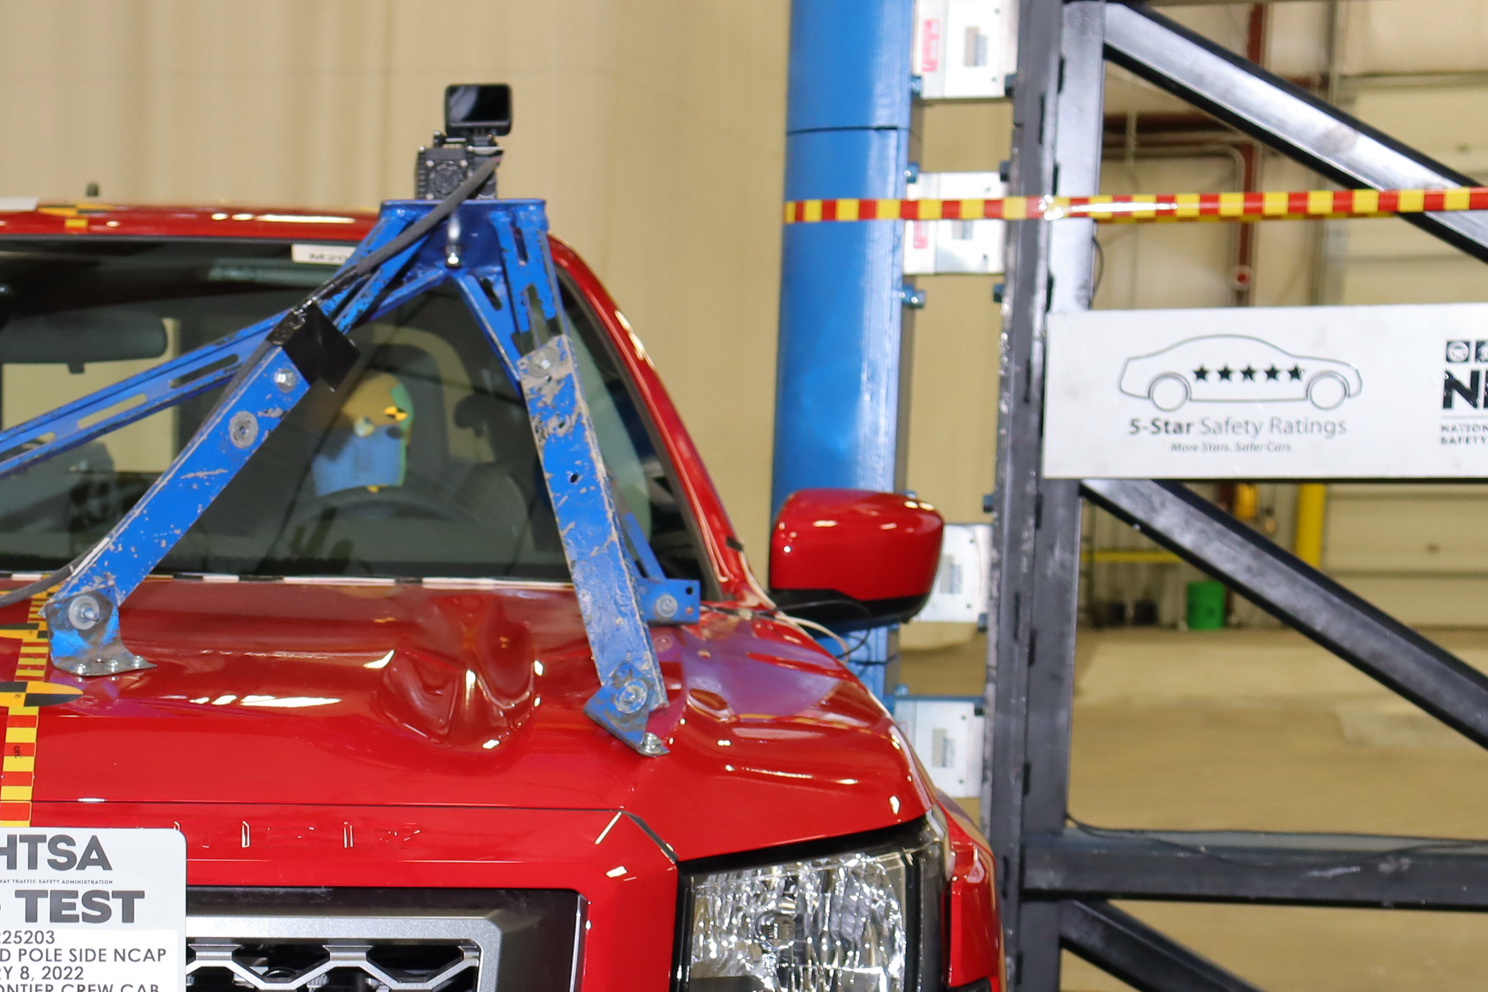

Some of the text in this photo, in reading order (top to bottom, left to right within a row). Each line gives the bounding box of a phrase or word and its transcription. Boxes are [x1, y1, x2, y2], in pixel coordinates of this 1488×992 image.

[1442, 369, 1488, 409] N
[1129, 415, 1347, 440] 5-Star Safety Ratings
[61, 878, 114, 886] ADMINISTRATION
[15, 890, 145, 923] TEST
[18, 947, 63, 963] POLE
[68, 947, 107, 963] SIDE
[113, 947, 167, 963] NCAP
[19, 965, 35, 982] 8,
[41, 965, 84, 981] 2022
